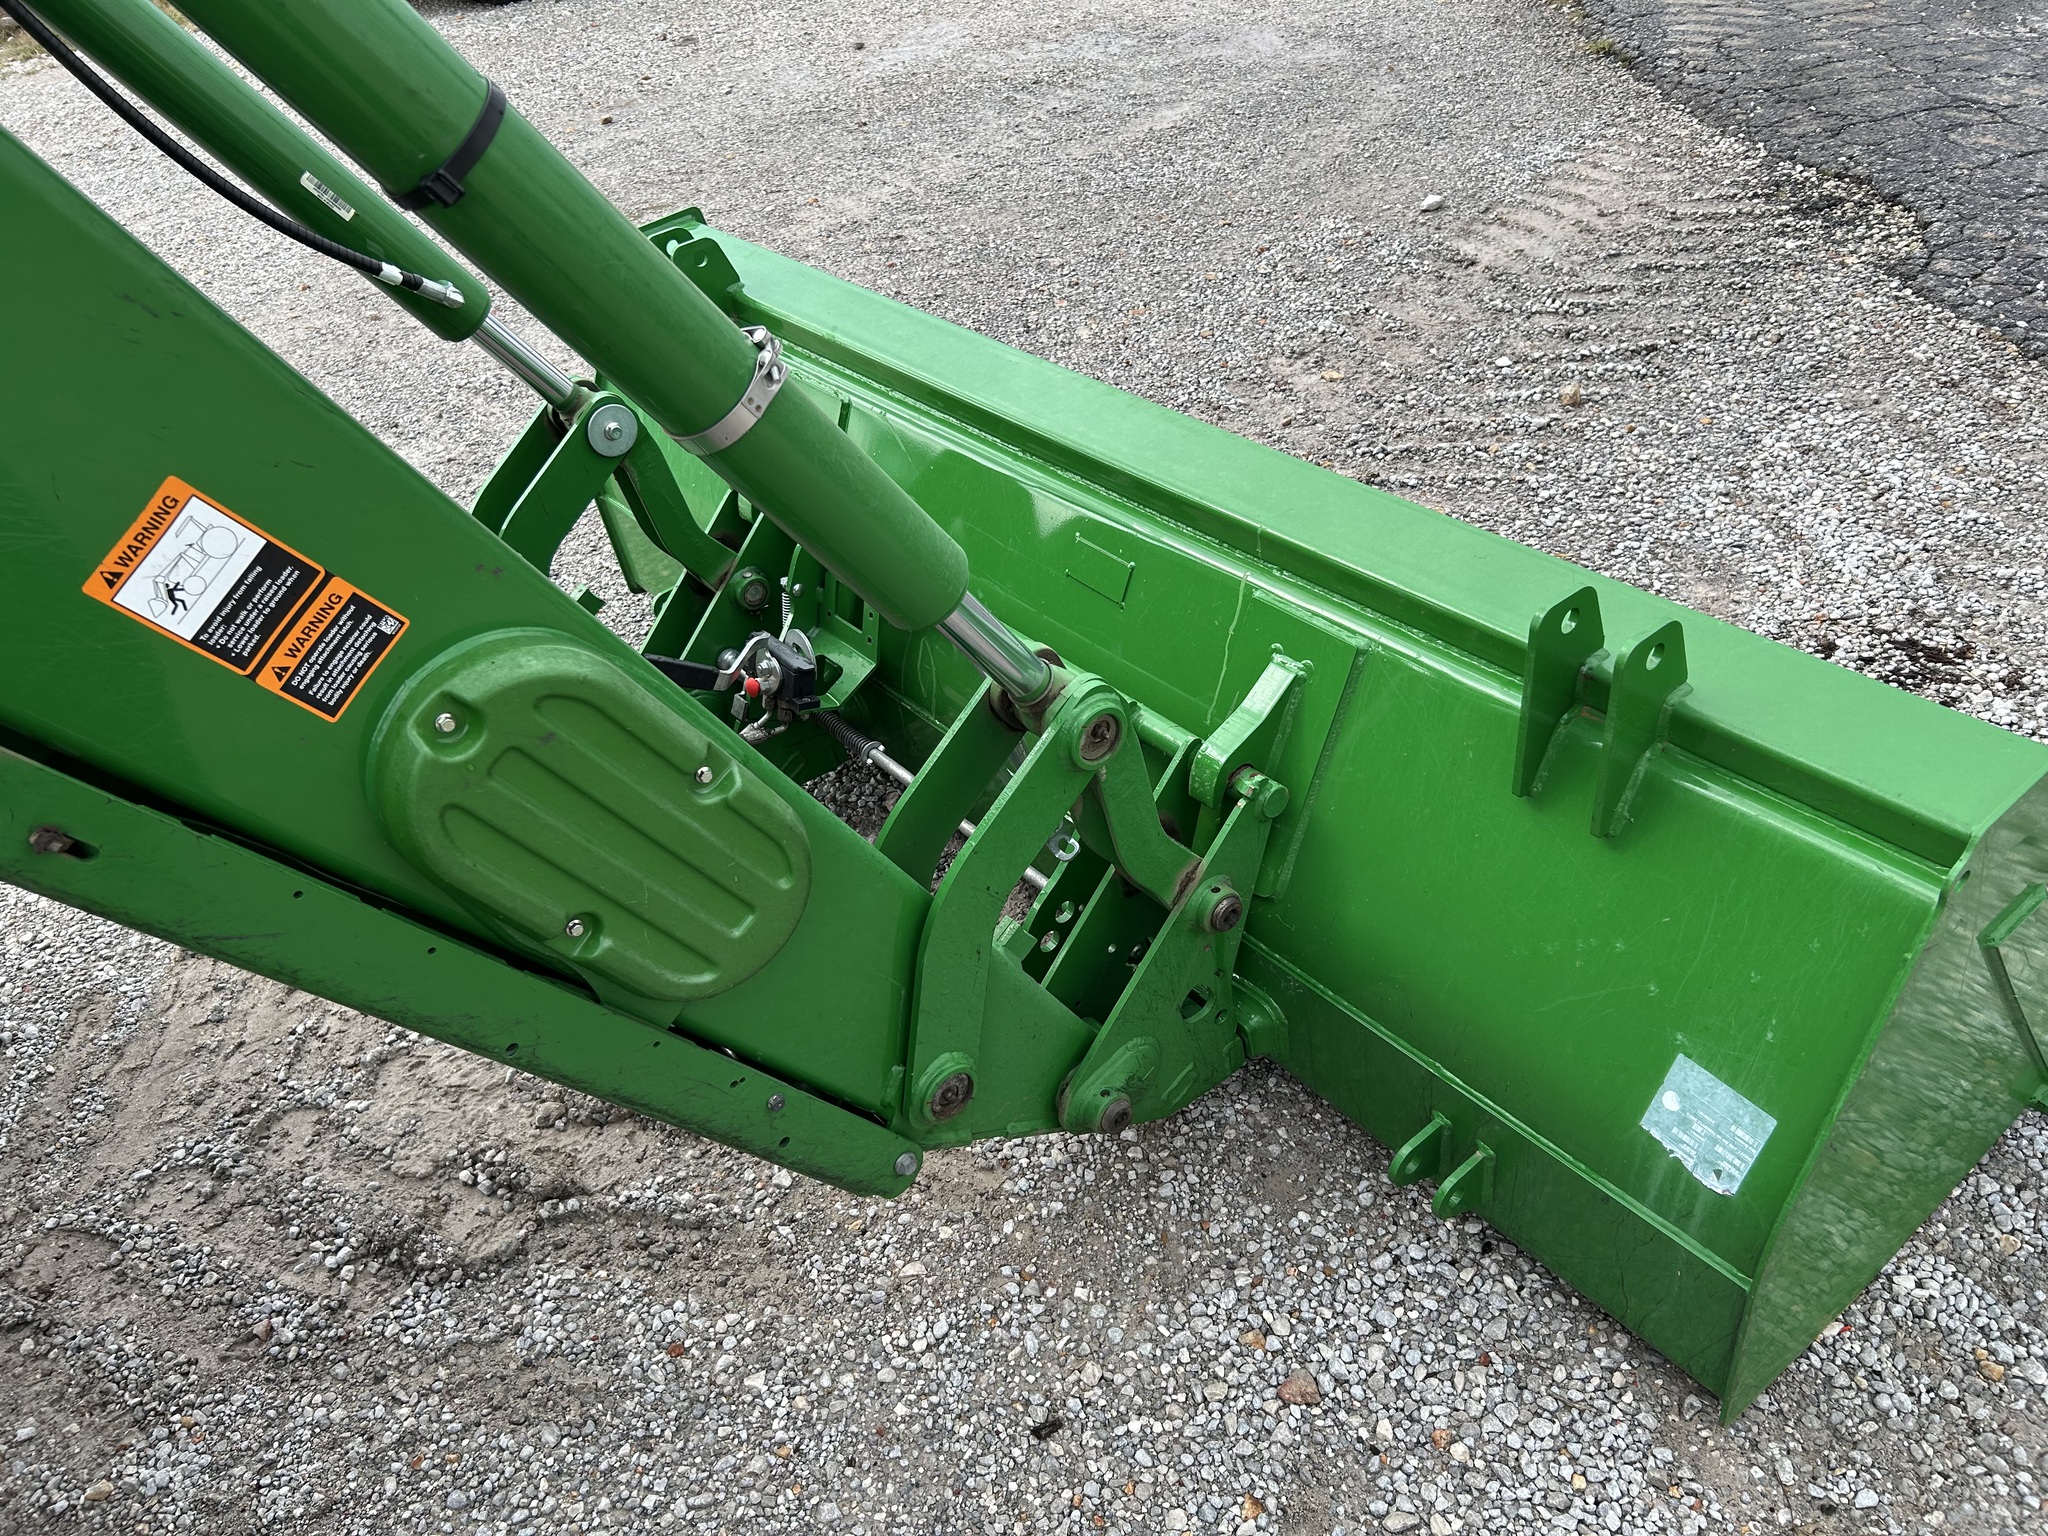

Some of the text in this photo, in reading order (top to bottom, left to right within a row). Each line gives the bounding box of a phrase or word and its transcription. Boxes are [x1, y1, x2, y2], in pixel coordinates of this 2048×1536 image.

[113, 495, 180, 568] WARNING
[199, 566, 263, 641] To avoid injury from falling
[207, 624, 227, 645] loader:
[218, 579, 273, 645] Do not walk or perform
[227, 626, 246, 648] service
[244, 608, 259, 626] under
[261, 584, 278, 604] raised
[275, 566, 294, 586] loader.
[233, 570, 300, 653] Lower loader to ground when
[284, 593, 343, 658] WARNING
[242, 634, 261, 657] parked.
[291, 605, 356, 686] DO NOT operate loader without
[299, 620, 354, 690] engaging attachment latch.
[308, 676, 325, 696] Failure
[327, 650, 344, 670] engage
[342, 629, 360, 651] retainer
[359, 614, 373, 630] could
[316, 682, 330, 699] result
[331, 647, 356, 677] attachment
[354, 621, 377, 648] detaching
[322, 632, 378, 702] from loader causing serious
[328, 688, 344, 706] bodily
[340, 673, 354, 689] injury
[357, 651, 372, 668] death.
